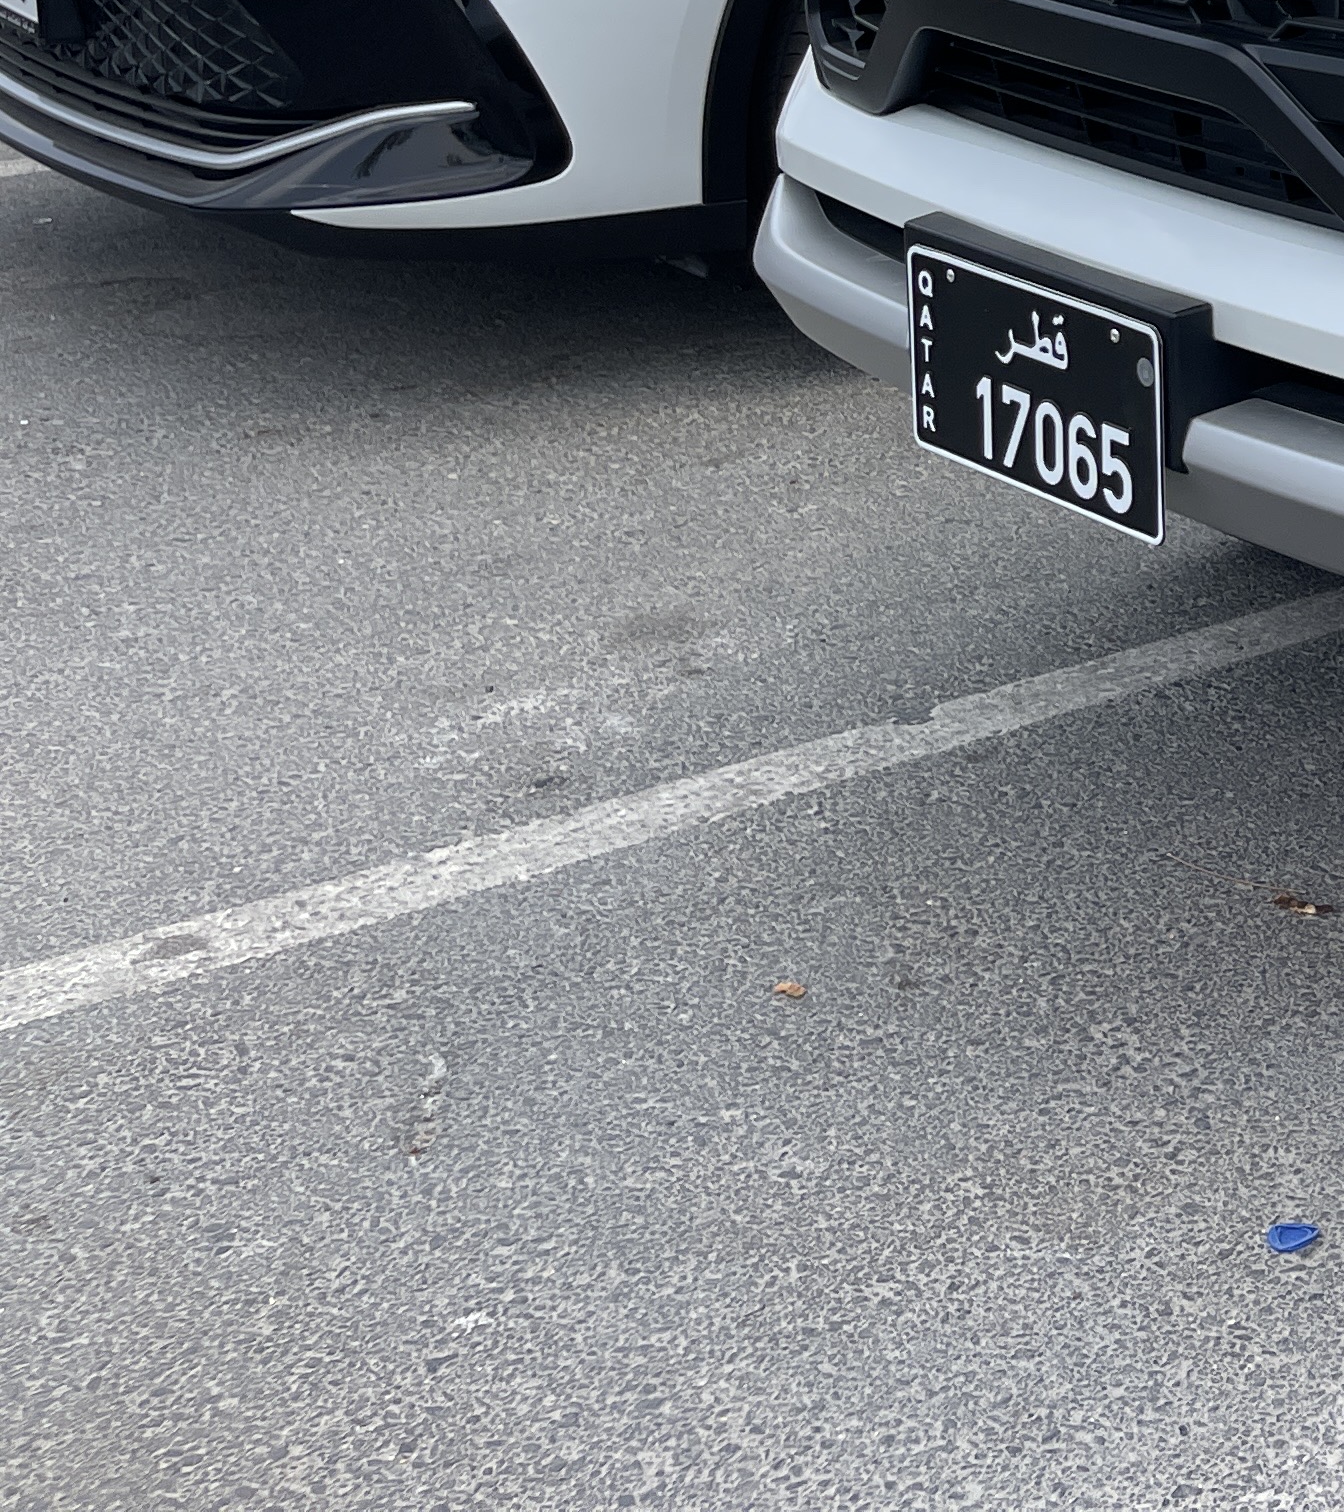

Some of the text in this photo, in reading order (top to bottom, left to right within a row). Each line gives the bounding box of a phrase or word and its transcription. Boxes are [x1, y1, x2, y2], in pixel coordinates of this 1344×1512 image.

[917, 270, 937, 433] QATAR
[995, 310, 1069, 371] قطر
[976, 375, 1133, 514] 17065
